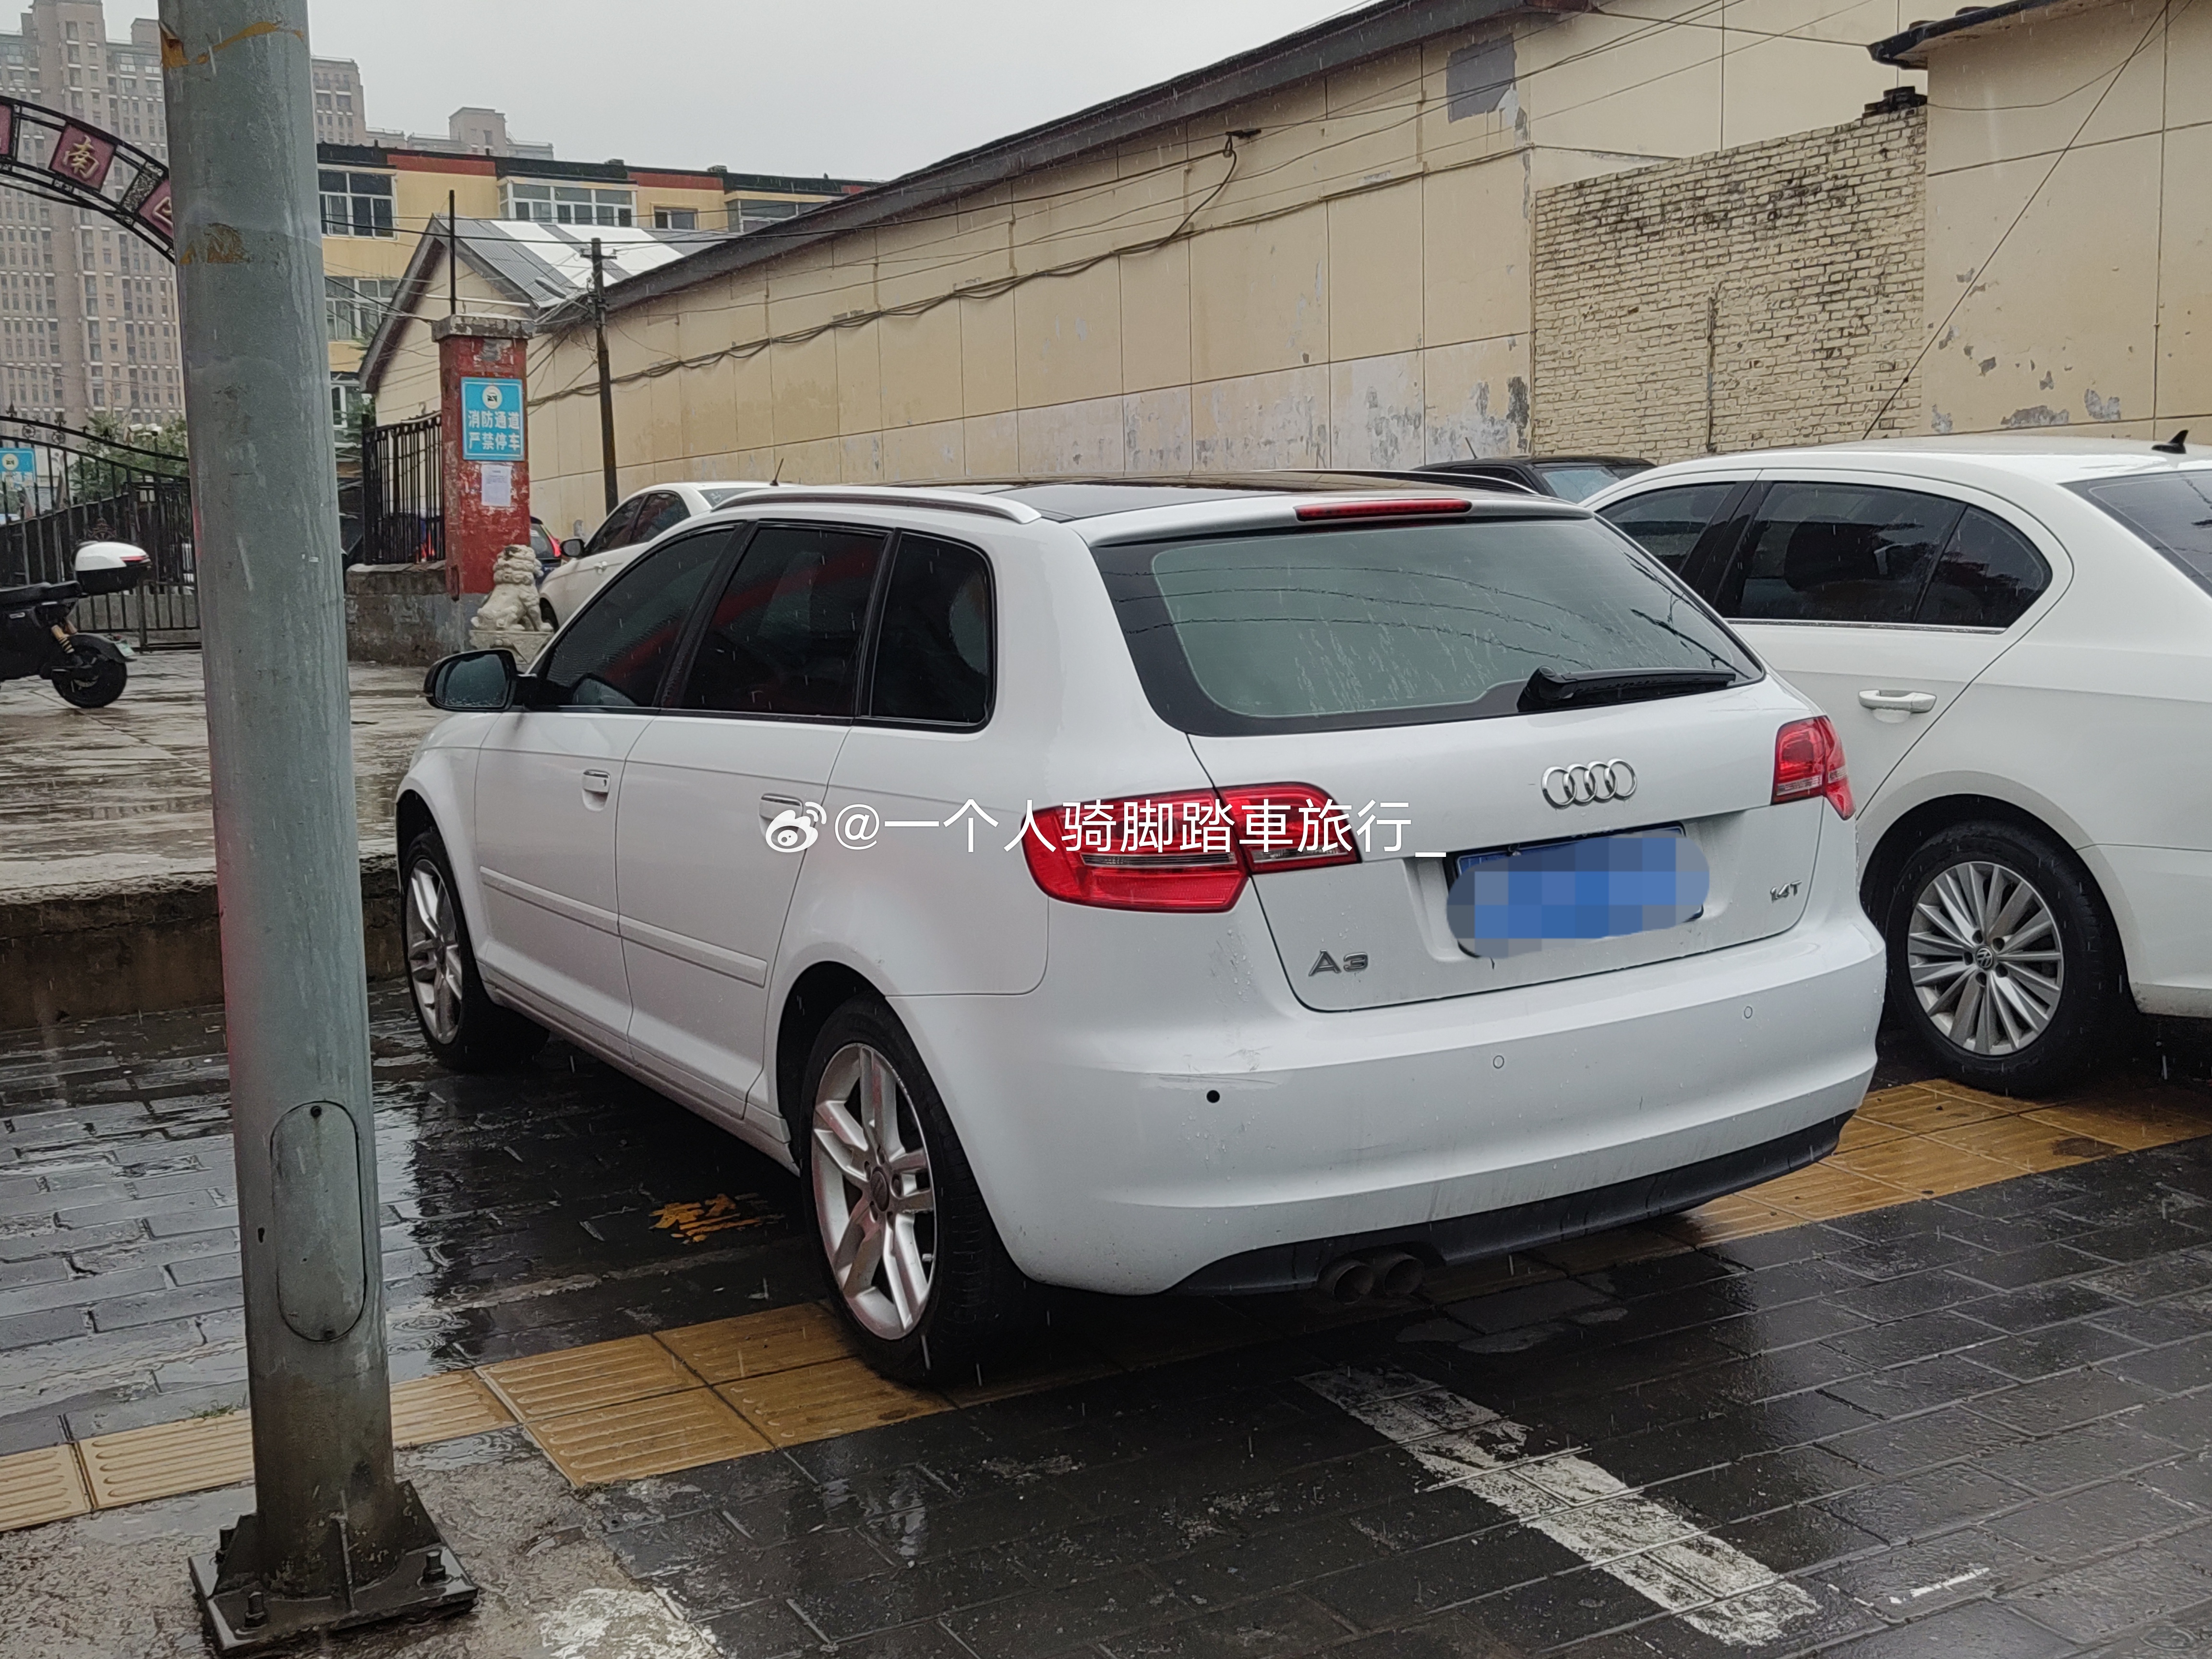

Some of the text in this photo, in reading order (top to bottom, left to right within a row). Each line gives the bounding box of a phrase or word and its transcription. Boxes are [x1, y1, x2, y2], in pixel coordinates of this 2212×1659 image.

[468, 409, 520, 429] 消防通道
[469, 432, 520, 451] 严禁停车
[1308, 949, 1368, 977] A3
